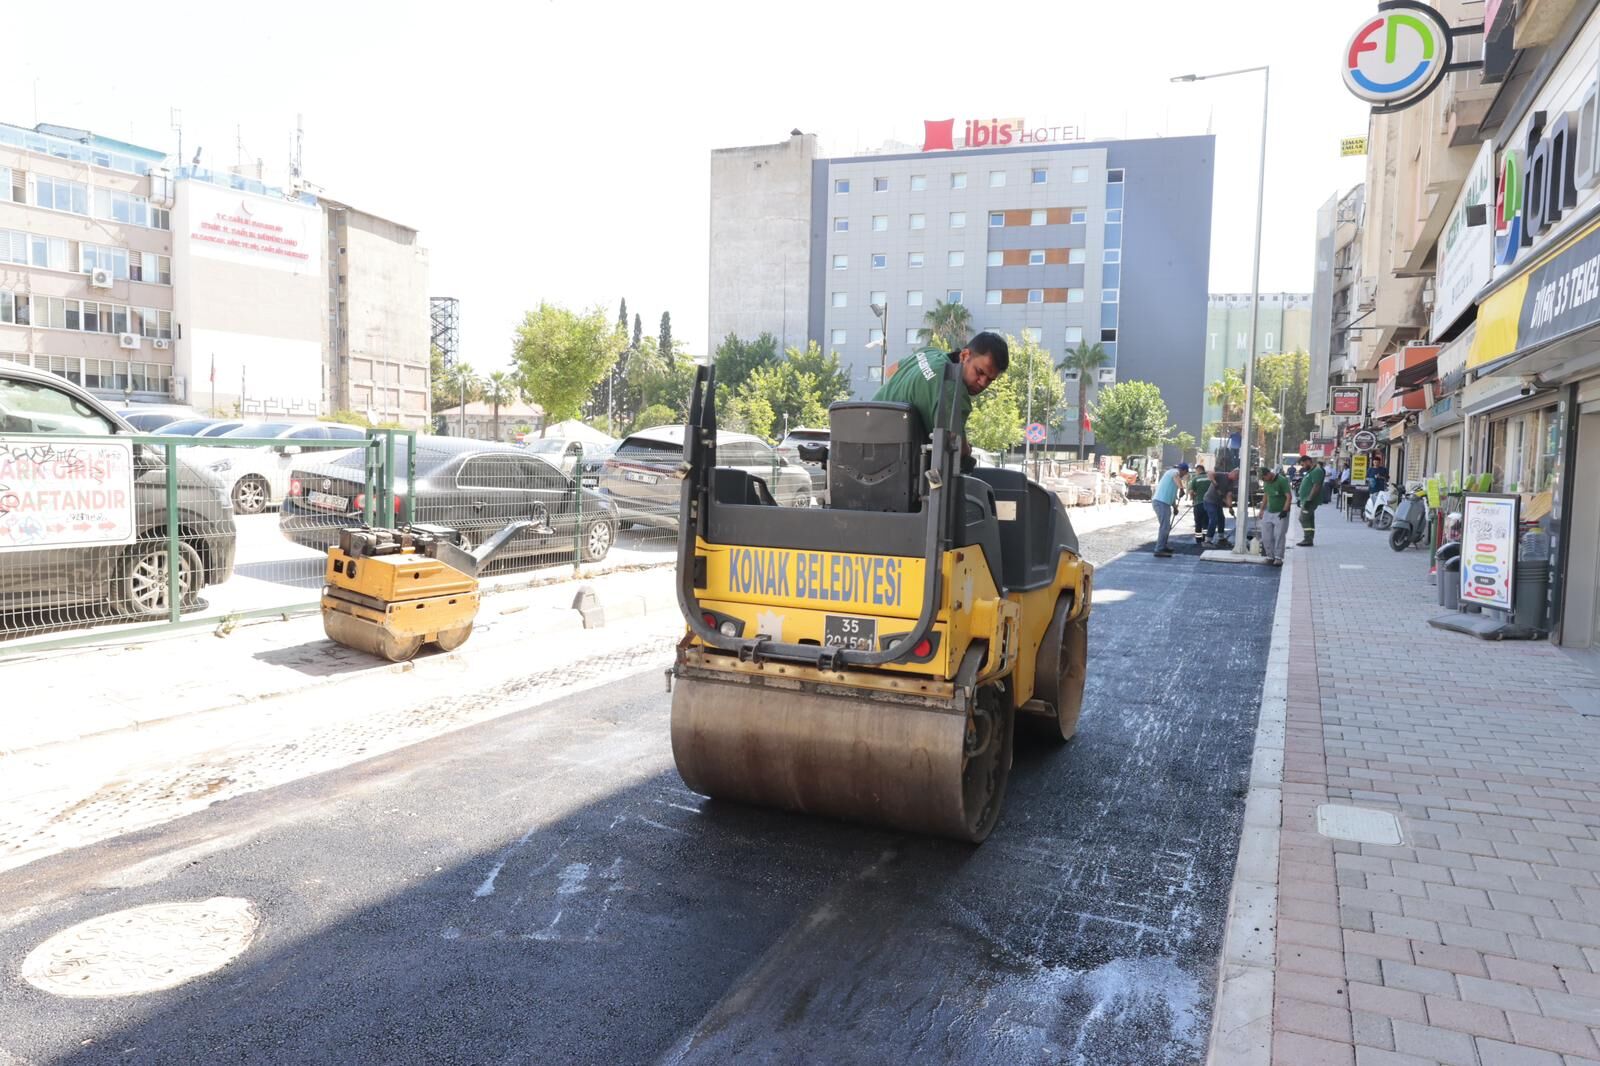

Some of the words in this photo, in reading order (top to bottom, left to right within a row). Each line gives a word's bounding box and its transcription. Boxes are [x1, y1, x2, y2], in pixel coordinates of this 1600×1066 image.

[964, 118, 1013, 147] ibis
[1020, 126, 1086, 143] HOTEL
[729, 548, 790, 597] KONAK
[842, 619, 859, 633] 35
